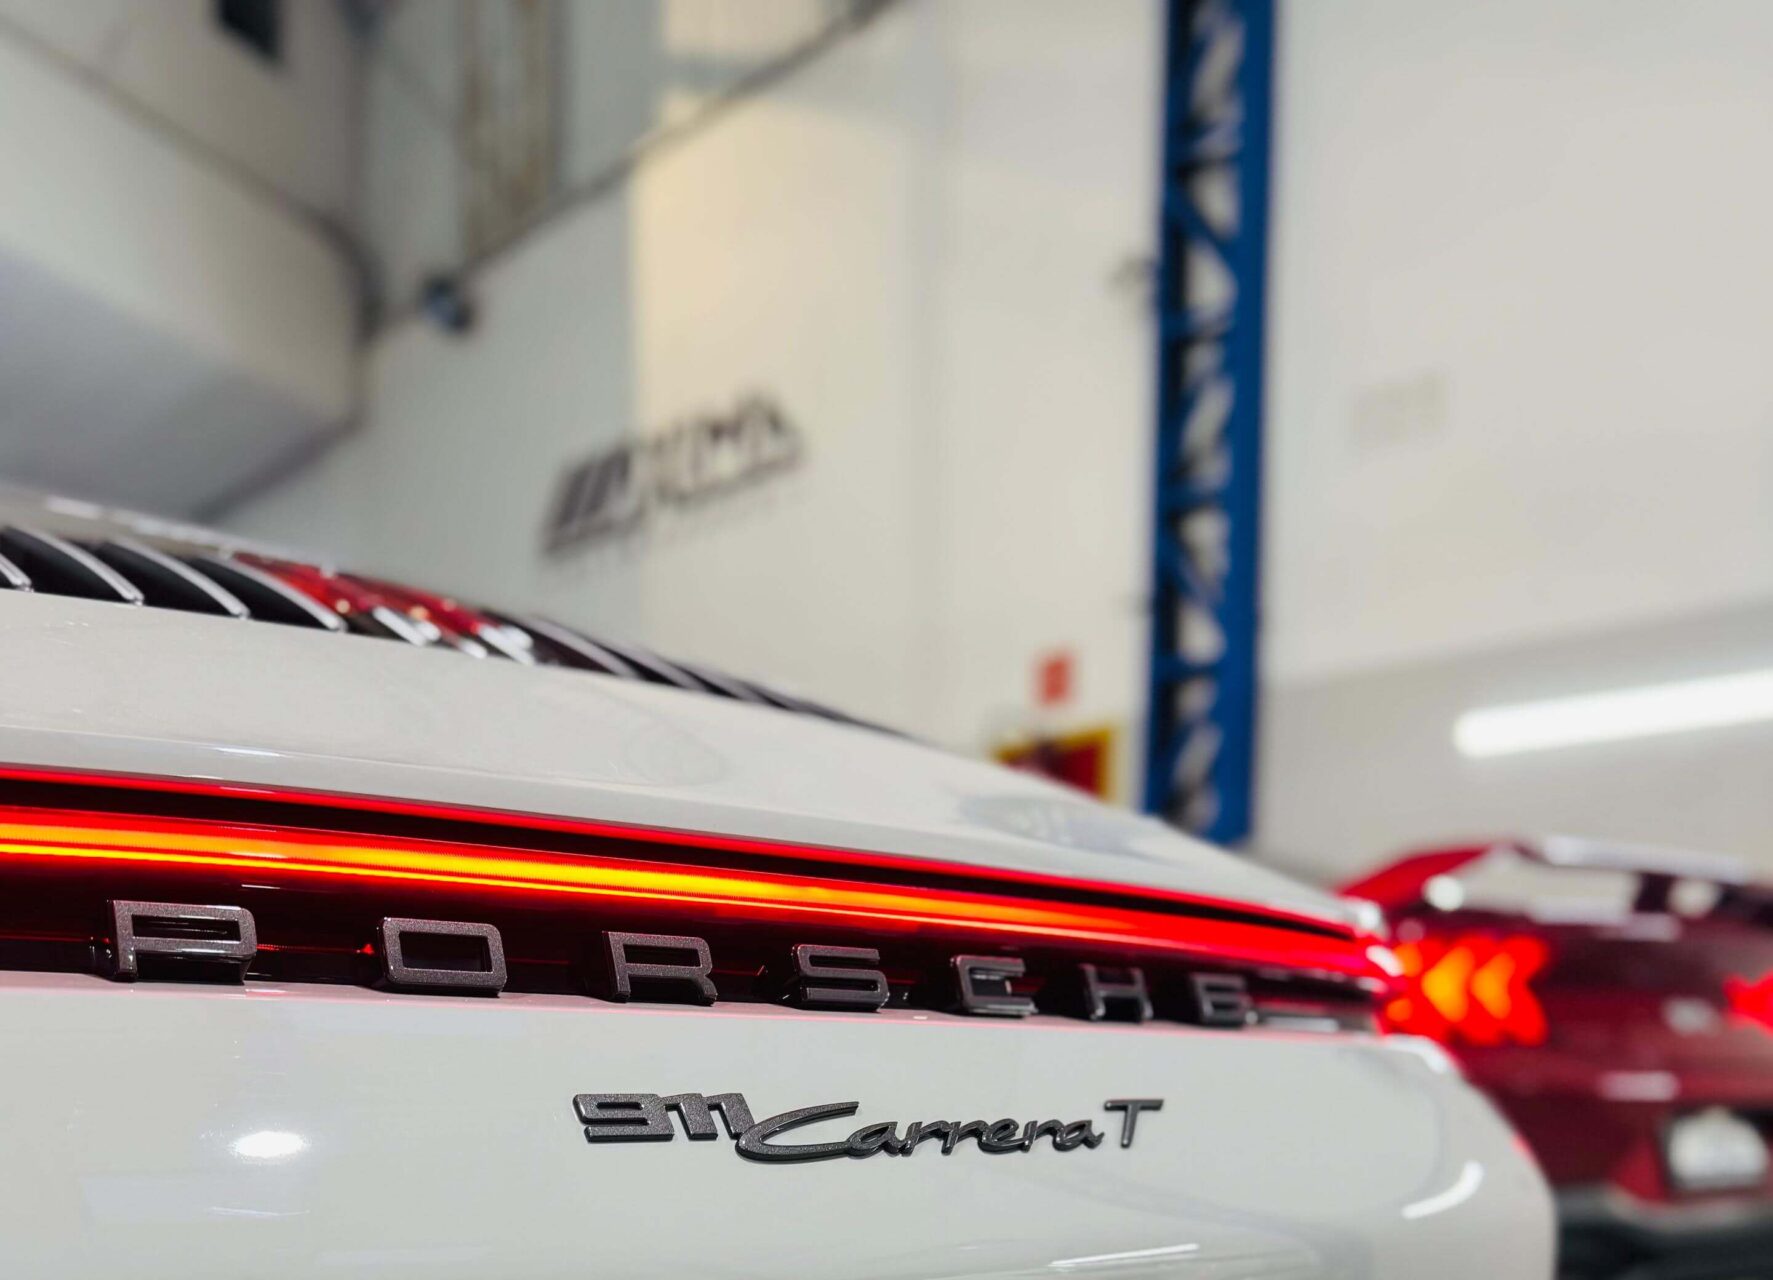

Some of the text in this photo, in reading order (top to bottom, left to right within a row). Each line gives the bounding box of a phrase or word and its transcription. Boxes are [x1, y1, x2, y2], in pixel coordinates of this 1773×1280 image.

[108, 899, 1252, 1027] PORSCHE
[572, 1093, 1164, 1163] 911 Carrera T
